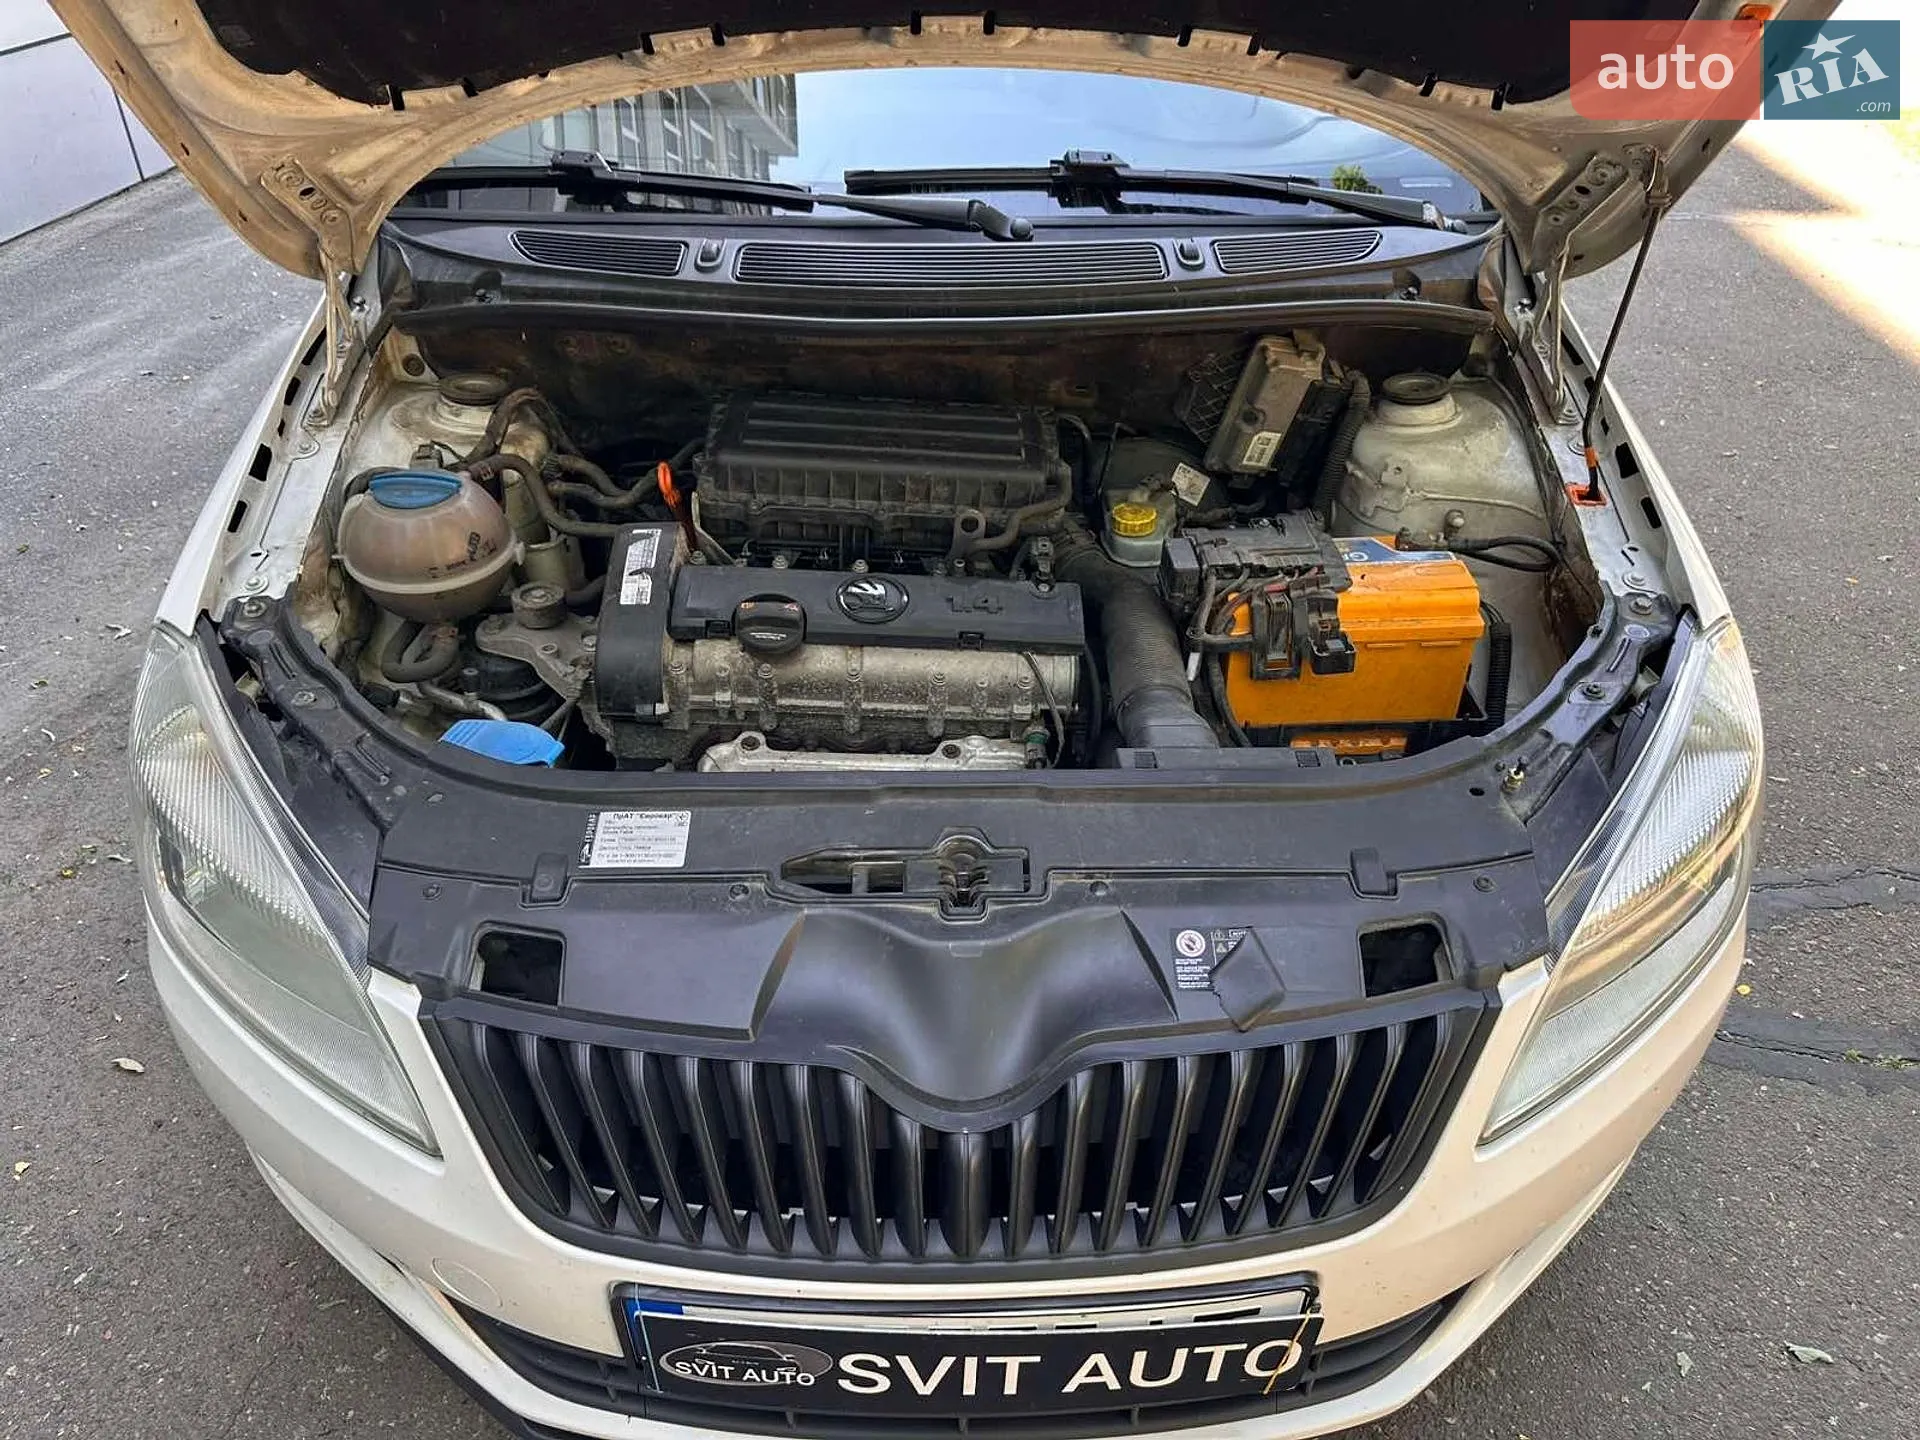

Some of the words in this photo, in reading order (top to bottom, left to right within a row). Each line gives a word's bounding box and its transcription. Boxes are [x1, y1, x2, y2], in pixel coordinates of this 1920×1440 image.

[674, 1361, 736, 1379] SVIT
[742, 1367, 816, 1387] AUTO
[837, 1352, 1042, 1396] SVIT
[1061, 1339, 1301, 1393] AUTO
